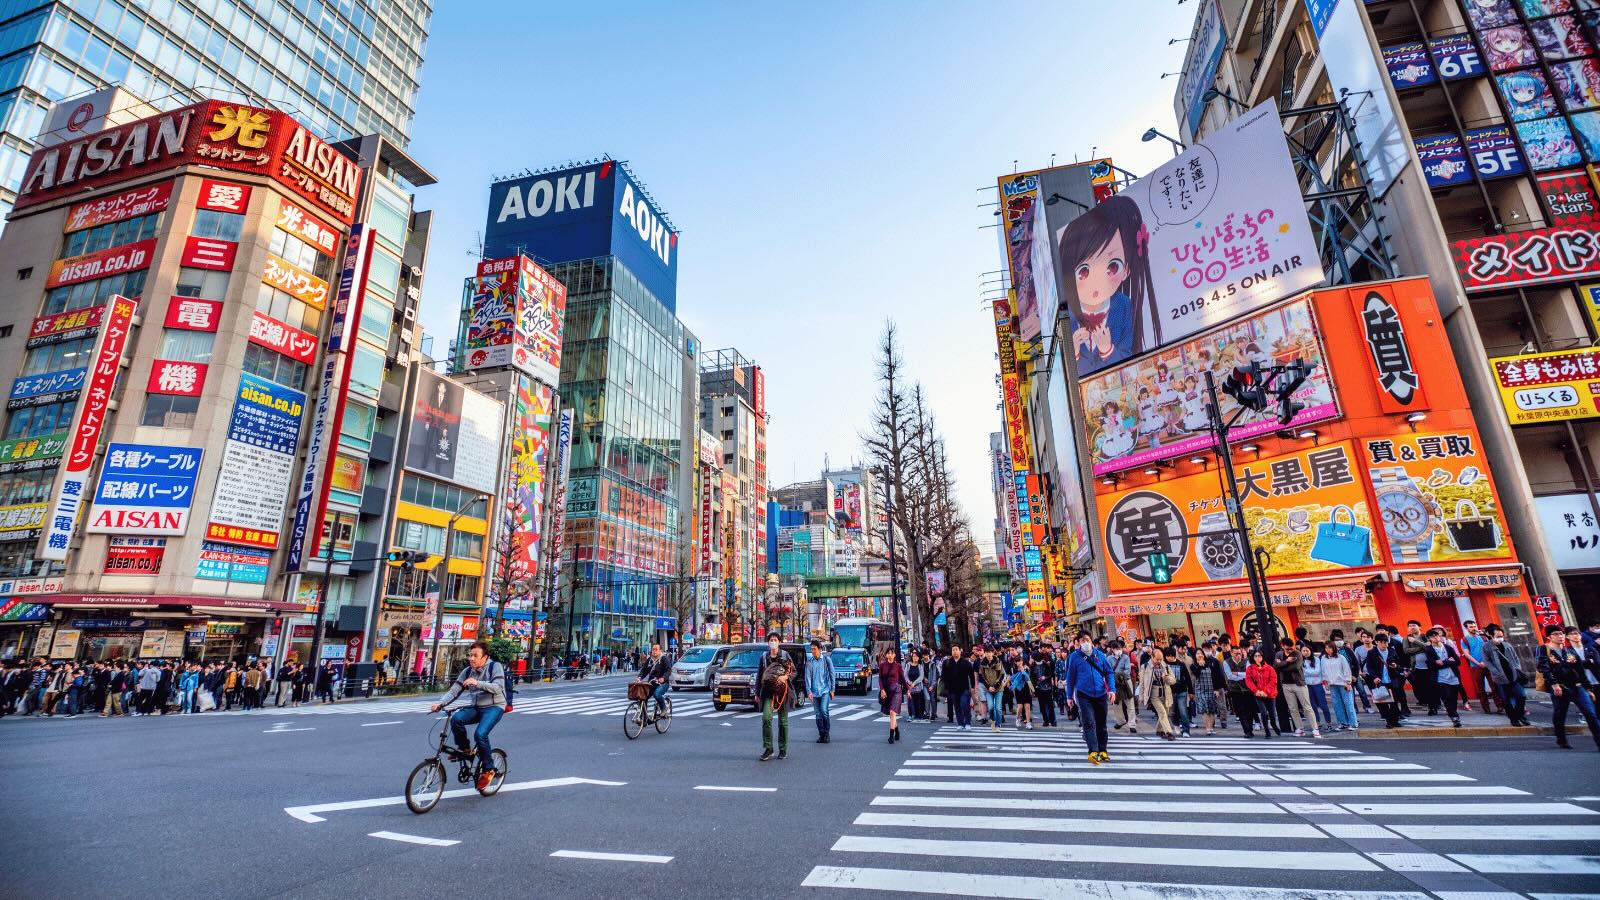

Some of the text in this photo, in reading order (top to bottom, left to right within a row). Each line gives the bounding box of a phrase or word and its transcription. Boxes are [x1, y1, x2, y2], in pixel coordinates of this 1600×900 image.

[1382, 36, 1468, 56] トレーディング カードゲーム
[1384, 51, 1427, 65] アメニティ
[1439, 52, 1480, 78] 6F
[209, 106, 270, 149] 光
[1416, 130, 1505, 150] トレーディング カードゲーム
[23, 109, 195, 195] AISAN
[198, 145, 270, 165] ネットワーク
[286, 127, 360, 199] AISAN
[1418, 145, 1462, 159] アメニティ
[1473, 147, 1520, 175] 5F
[1175, 167, 1193, 211] なりたい
[1187, 156, 1206, 193] 友達に
[497, 171, 596, 223] AOKI
[1550, 200, 1594, 216] Stars
[278, 205, 336, 252] 光通信
[619, 183, 670, 267] AOKI
[1171, 209, 1274, 264] ひとりぼっちの
[58, 249, 146, 283] aisan.co.jp
[483, 260, 515, 273] 免税店
[1470, 232, 1600, 280] メイド
[158, 184, 242, 392] 愛 三 電 機
[263, 258, 328, 302] ネットワーク
[1171, 283, 1237, 320] 2019.4.5
[1240, 269, 1268, 289] ON
[1271, 254, 1303, 278] AIR
[34, 318, 51, 333] 3F
[249, 317, 315, 357] 配線パーツ
[1361, 304, 1419, 393] 質
[15, 370, 86, 395] 2F ネットワーク
[73, 302, 133, 464] 光・ケーブル・ネットワーク
[1503, 357, 1600, 383] 全身もみほ
[240, 386, 302, 417] aisan.co.jp
[1516, 406, 1589, 420] 秋葉原中央通り店
[1519, 390, 1573, 406] りらくる
[109, 449, 196, 471] 各種ケーブル
[1368, 435, 1475, 464] 質&買取
[1235, 446, 1354, 503] 大黒屋
[100, 480, 189, 500] 配線パーツ
[48, 479, 82, 550] 愛三電機
[92, 510, 183, 530] AISAN
[1007, 489, 1021, 553] Tax-free Shop
[1564, 511, 1593, 529] 喫茶
[290, 500, 308, 565] AISAN
[1114, 499, 1182, 574] 質
[107, 556, 162, 572] aisan.co.jp
[1427, 573, 1520, 589] 1階にて高価買取中
[1536, 596, 1552, 608] 4F
[464, 622, 476, 631] au
